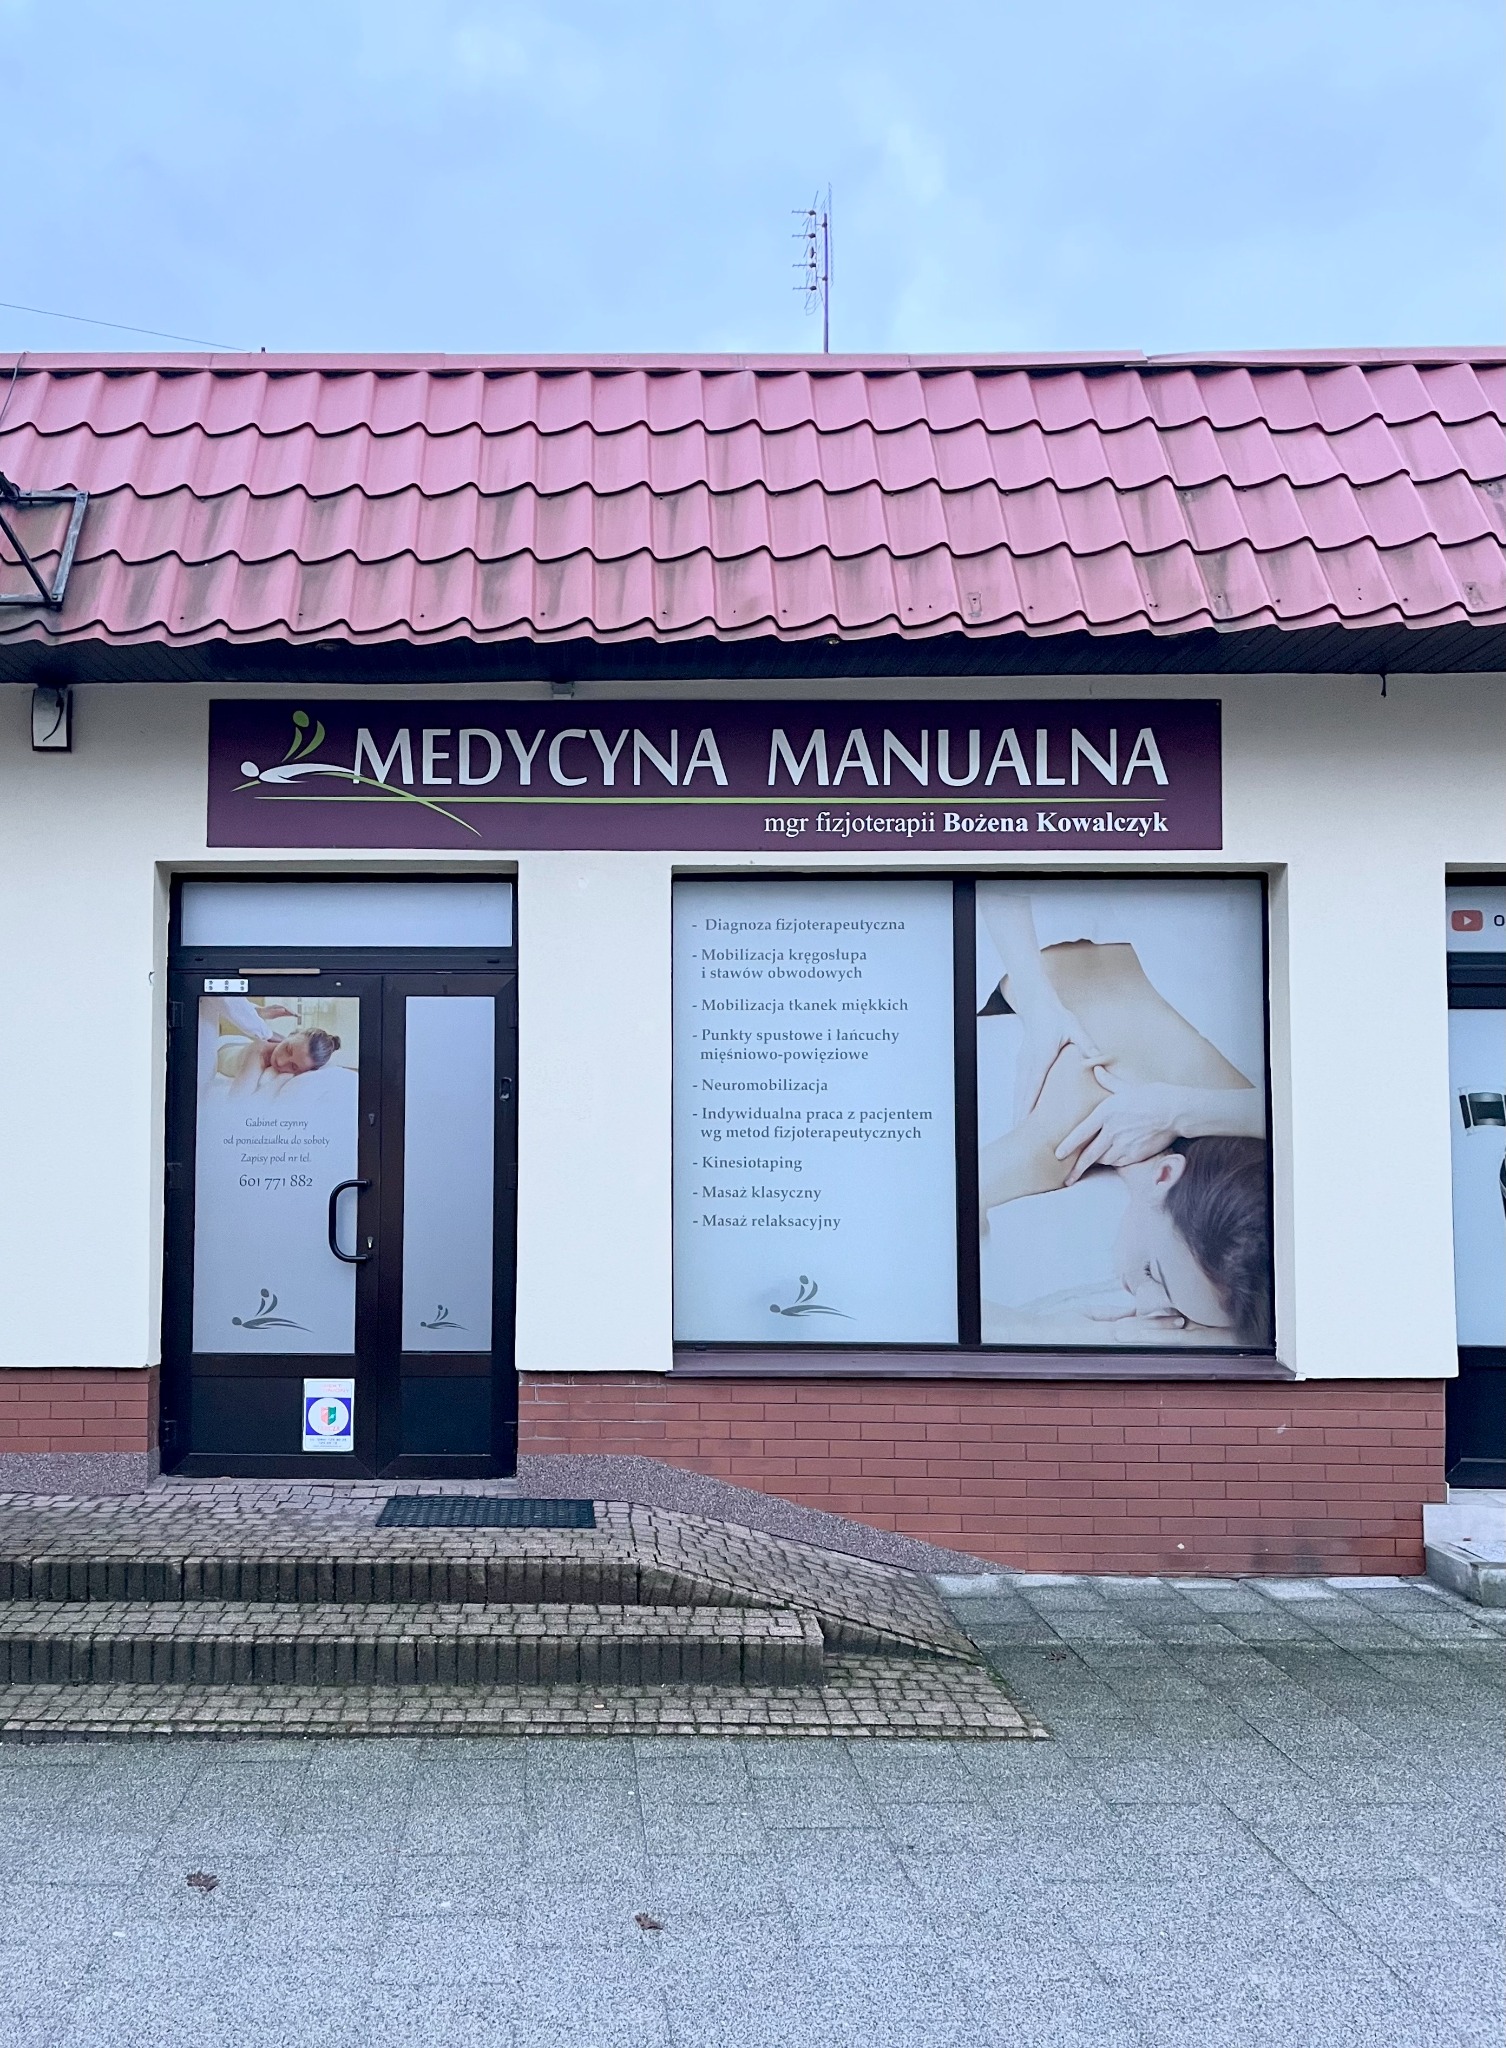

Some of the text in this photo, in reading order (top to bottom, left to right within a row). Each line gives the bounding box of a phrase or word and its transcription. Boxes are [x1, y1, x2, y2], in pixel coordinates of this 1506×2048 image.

[352, 728, 1169, 786] MEDYCYNA MANUALNA
[764, 811, 1169, 838] mgr fizjoterapii Bożena Kowalczyk
[705, 918, 772, 934] Diagnoza
[776, 918, 905, 934] fizjoterapeutyczna
[701, 949, 784, 964] Mobilizacja
[789, 948, 867, 965] kręgosłupa
[701, 967, 863, 983] i stawów obwodowych
[701, 999, 784, 1014] Mobilizacja
[789, 999, 837, 1011] tkanek
[842, 999, 909, 1014] miękkich
[701, 1029, 752, 1045] Punkty
[756, 1030, 823, 1045] spustowe
[827, 1029, 832, 1041] i
[836, 1029, 900, 1045] łańcuchy
[700, 1047, 869, 1064] mięśniowo-powięziowe
[702, 1079, 828, 1094] Neuromobilizacja
[702, 1107, 801, 1123] Indywidualna
[806, 1111, 843, 1123] praca
[847, 1111, 856, 1120] z
[860, 1108, 933, 1123] pacjentem
[245, 1117, 309, 1130] Gabinet czynny
[223, 1134, 331, 1148] od poniedziałku do soboty
[701, 1126, 922, 1142] wg metod fizjoterapeutycznych
[240, 1153, 268, 1166] Zapisy
[270, 1152, 286, 1166] pod
[299, 1152, 312, 1163] tel.
[702, 1156, 803, 1172] Kinesiotaping
[239, 1174, 313, 1191] 601 771 882
[702, 1186, 747, 1199] Masaż
[751, 1186, 822, 1202] klasyczny
[702, 1214, 747, 1227] Masaż
[752, 1214, 841, 1230] relaksacyjny
